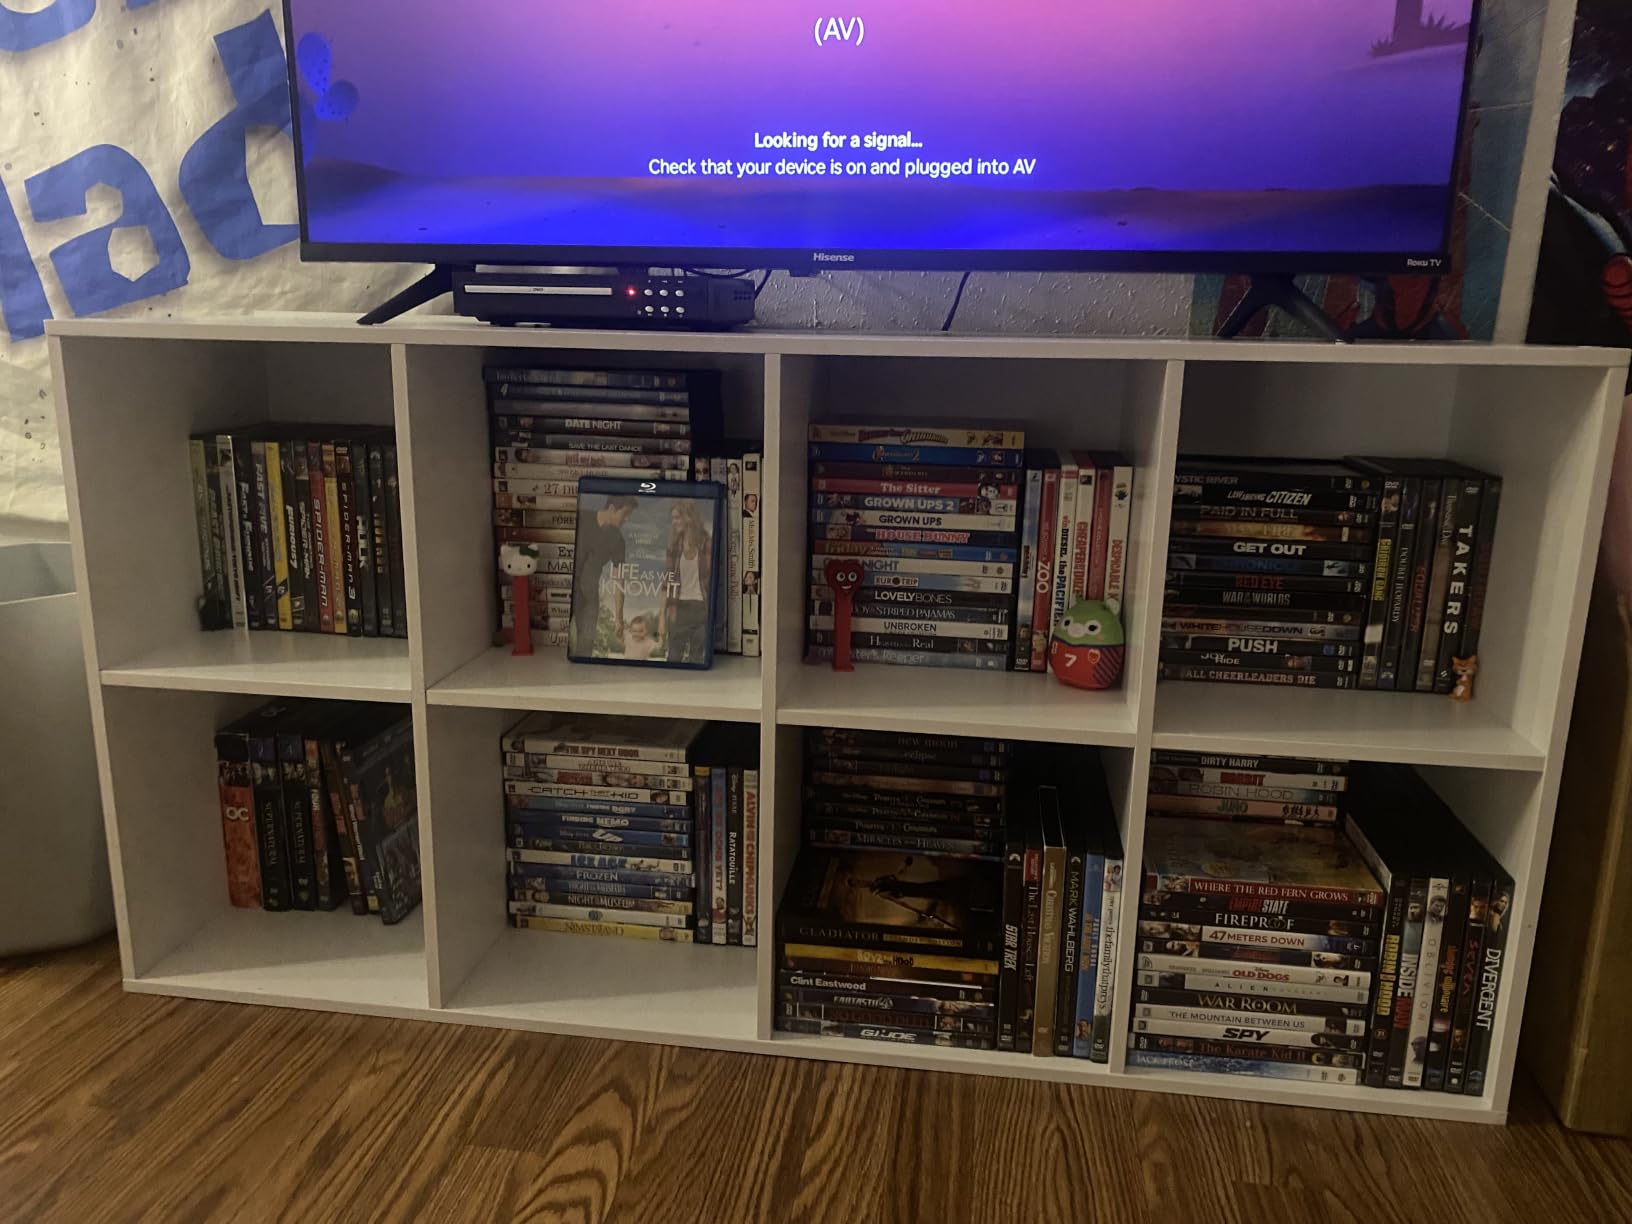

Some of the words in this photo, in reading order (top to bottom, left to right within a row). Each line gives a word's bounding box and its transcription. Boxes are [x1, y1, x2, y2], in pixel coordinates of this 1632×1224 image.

[814, 16, 865, 46] (AV)
[754, 131, 818, 151] Looking
[822, 131, 846, 148] for
[850, 135, 860, 148] a
[864, 131, 923, 151] signal...
[648, 158, 696, 175] Check
[700, 159, 733, 175] that
[737, 162, 771, 179] your
[775, 158, 826, 175] device
[830, 159, 842, 175] is
[846, 163, 866, 175] on
[870, 159, 899, 175] and
[904, 158, 972, 179] plugged
[977, 159, 1009, 175] into
[1012, 159, 1036, 175] AV
[813, 251, 855, 262] Hisense
[1406, 258, 1427, 267] Roku
[1429, 258, 1442, 267] TV
[565, 418, 592, 430] DATE
[592, 419, 622, 431] NIGHT
[880, 482, 902, 492] The
[906, 484, 941, 494] Sitter
[1206, 477, 1239, 486] RIVER
[864, 497, 914, 508] GROWN
[918, 499, 943, 510] UPS
[946, 501, 954, 511] 2
[1266, 491, 1313, 506] CITIZEN
[879, 515, 919, 525] GROWN
[922, 516, 942, 526] UPS
[1200, 505, 1236, 516] PAID
[1241, 506, 1257, 517] IN
[1261, 507, 1298, 520] FULL
[341, 481, 354, 584] SPIDER-MAN
[876, 529, 920, 541] HOUSE
[923, 531, 970, 544] BUNNY
[1060, 527, 1070, 557] DIESEL
[1075, 521, 1089, 564] CHEAPER
[1233, 542, 1267, 554] GET
[1271, 544, 1307, 556] OUT
[313, 498, 329, 607] SPIDER-MAN
[748, 548, 756, 569] Smith
[609, 563, 639, 580] LIFE
[861, 559, 900, 571] NIGHT
[1109, 539, 1122, 590] DESPICABLE
[641, 570, 655, 581] AS
[657, 570, 676, 582] WE
[1036, 560, 1050, 593] ZOO
[1443, 524, 1473, 635] TAKERS
[600, 580, 661, 598] KNOW
[665, 582, 681, 599] IT
[1222, 591, 1243, 603] WAR
[1252, 593, 1291, 605] WORLDS
[916, 607, 956, 619] PAJAMAS
[884, 621, 937, 632] UNBROKEN
[912, 638, 934, 649] Real
[1228, 638, 1278, 654] PUSH
[1064, 653, 1078, 668] 7
[1215, 656, 1240, 665] RIDE
[1186, 670, 1207, 679] ALL
[1209, 671, 1294, 684] CHEERLEADERS
[1297, 675, 1316, 685] DIE
[1201, 757, 1227, 767] DIRTY
[1228, 758, 1259, 769] HARRY
[528, 786, 589, 797] CATCH
[611, 791, 639, 800] KID
[1189, 783, 1239, 797] ROBIN
[1246, 786, 1294, 800] HOOD
[226, 805, 250, 822] OC
[745, 791, 756, 829] ALVIN
[596, 816, 629, 827] NEMO
[294, 800, 306, 865] SUPERNATURAL
[576, 871, 619, 882] FROZEN
[1069, 871, 1079, 907] MARK
[1194, 881, 1231, 893] WHERE
[1235, 884, 1255, 894] THE
[1258, 885, 1278, 895] RED
[1281, 886, 1307, 898] FERN
[1310, 889, 1349, 902] GROWS
[568, 895, 594, 906] NIGHT
[600, 897, 635, 909] MUSEUM
[1261, 899, 1289, 914] STATE
[799, 927, 879, 942] GLADIATOR
[1004, 923, 1018, 948] STAR
[1064, 906, 1078, 972] WAHLBERG
[1209, 930, 1226, 941] 47
[1227, 933, 1268, 944] METERS
[1271, 936, 1305, 947] DOWN
[1003, 948, 1017, 972] TREK
[1382, 934, 1400, 973] ROBIN
[1232, 970, 1255, 979] OLD
[1257, 972, 1290, 982] DOGS
[1397, 952, 1419, 997] INSIDE
[1419, 937, 1437, 1021] OBLIVION
[790, 976, 814, 986] Clint
[815, 978, 867, 991] Eastwood
[1475, 947, 1502, 1031] DIVERGENT
[1198, 994, 1236, 1009] WAR
[1241, 996, 1297, 1014] ROOM
[1376, 981, 1393, 1016] HOOD
[1169, 1011, 1188, 1019] THE
[1190, 1012, 1242, 1024] MOUNTAIN
[1244, 1015, 1291, 1028] BETWEEN
[1293, 1021, 1305, 1029] US
[1222, 1028, 1271, 1041] SPY
[1200, 1040, 1222, 1053] The
[1225, 1043, 1265, 1056] Karate
[1271, 1046, 1294, 1059] Kid
